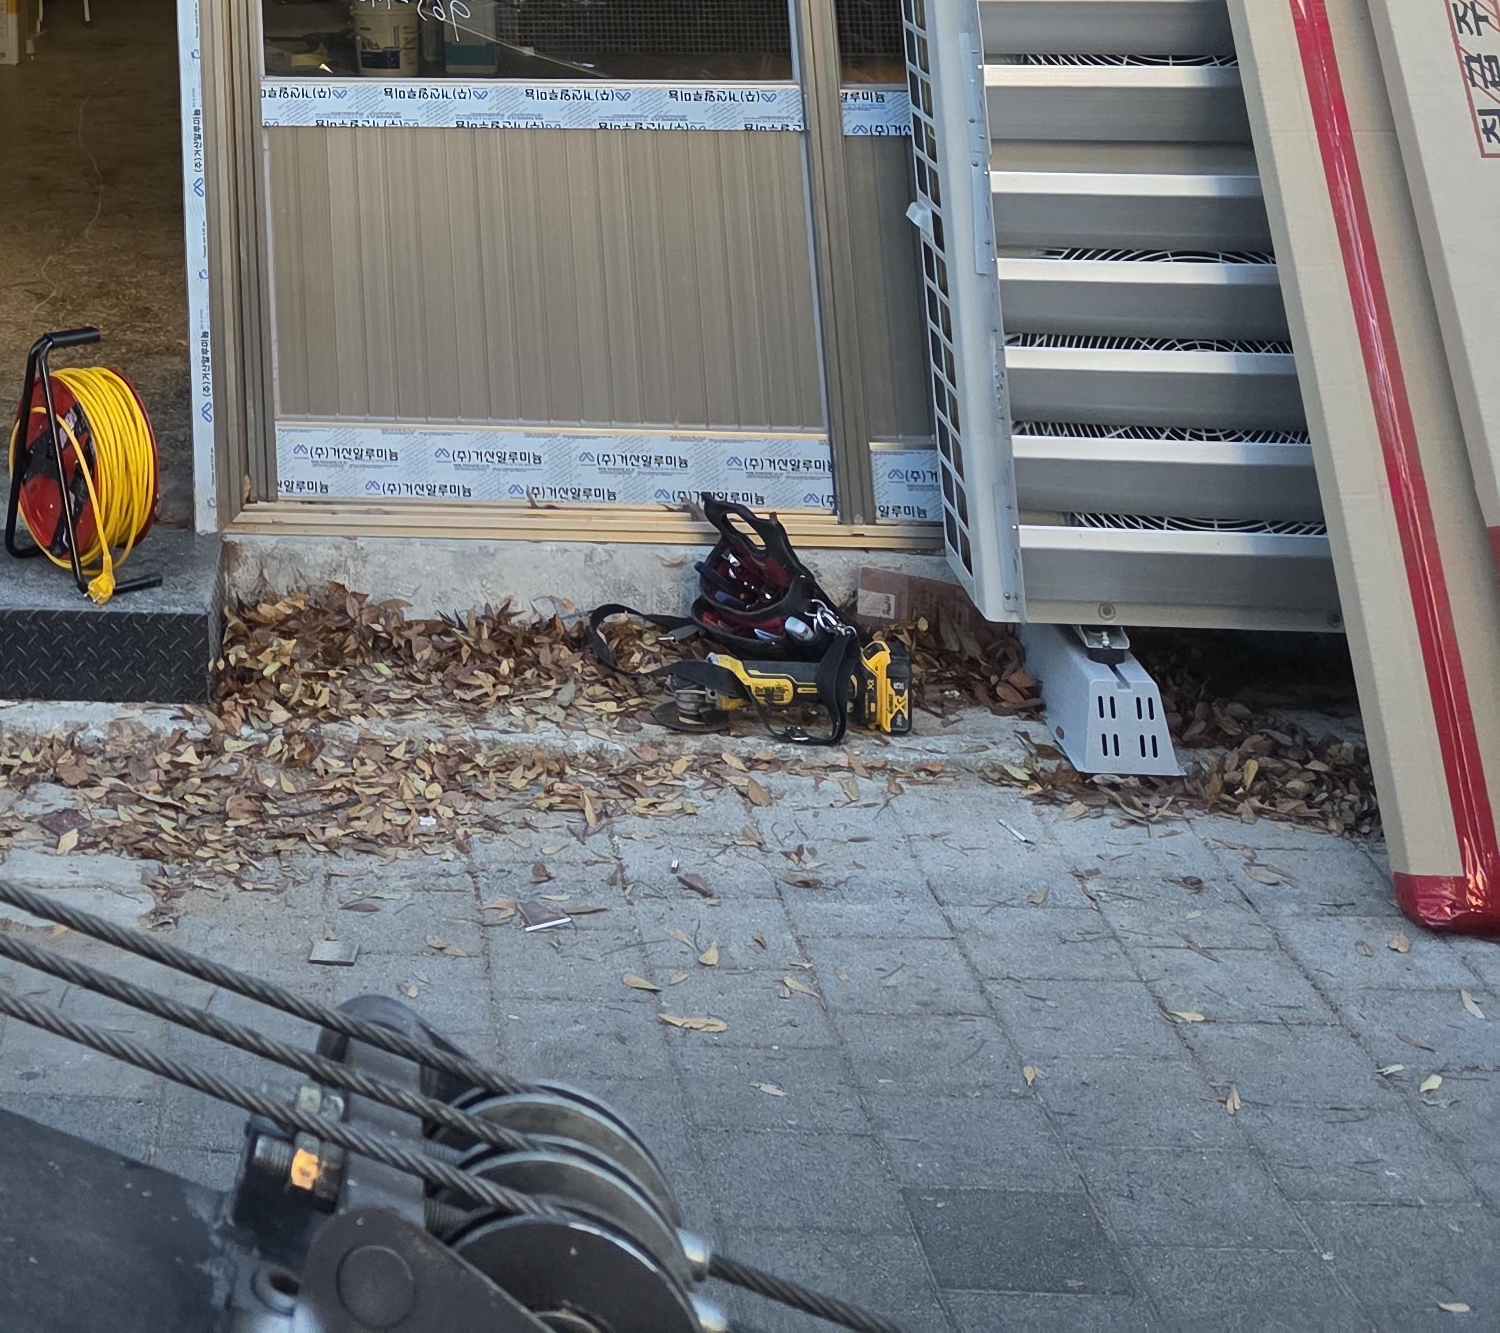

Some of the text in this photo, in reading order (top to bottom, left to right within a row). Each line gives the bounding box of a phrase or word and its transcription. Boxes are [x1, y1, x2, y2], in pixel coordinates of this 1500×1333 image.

[383, 87, 473, 101] (주)거산알루미늄
[524, 87, 615, 102] (주)거산알루미늄
[668, 88, 760, 103] (주)거산알루미늄
[197, 331, 211, 398] (주)거산알루미늄
[310, 447, 399, 462] (주)거산알루미늄
[451, 449, 543, 465] (주)거산알루미늄
[596, 453, 689, 469] (주)거산알루미늄
[382, 482, 471, 497] (주)거산알루미늄
